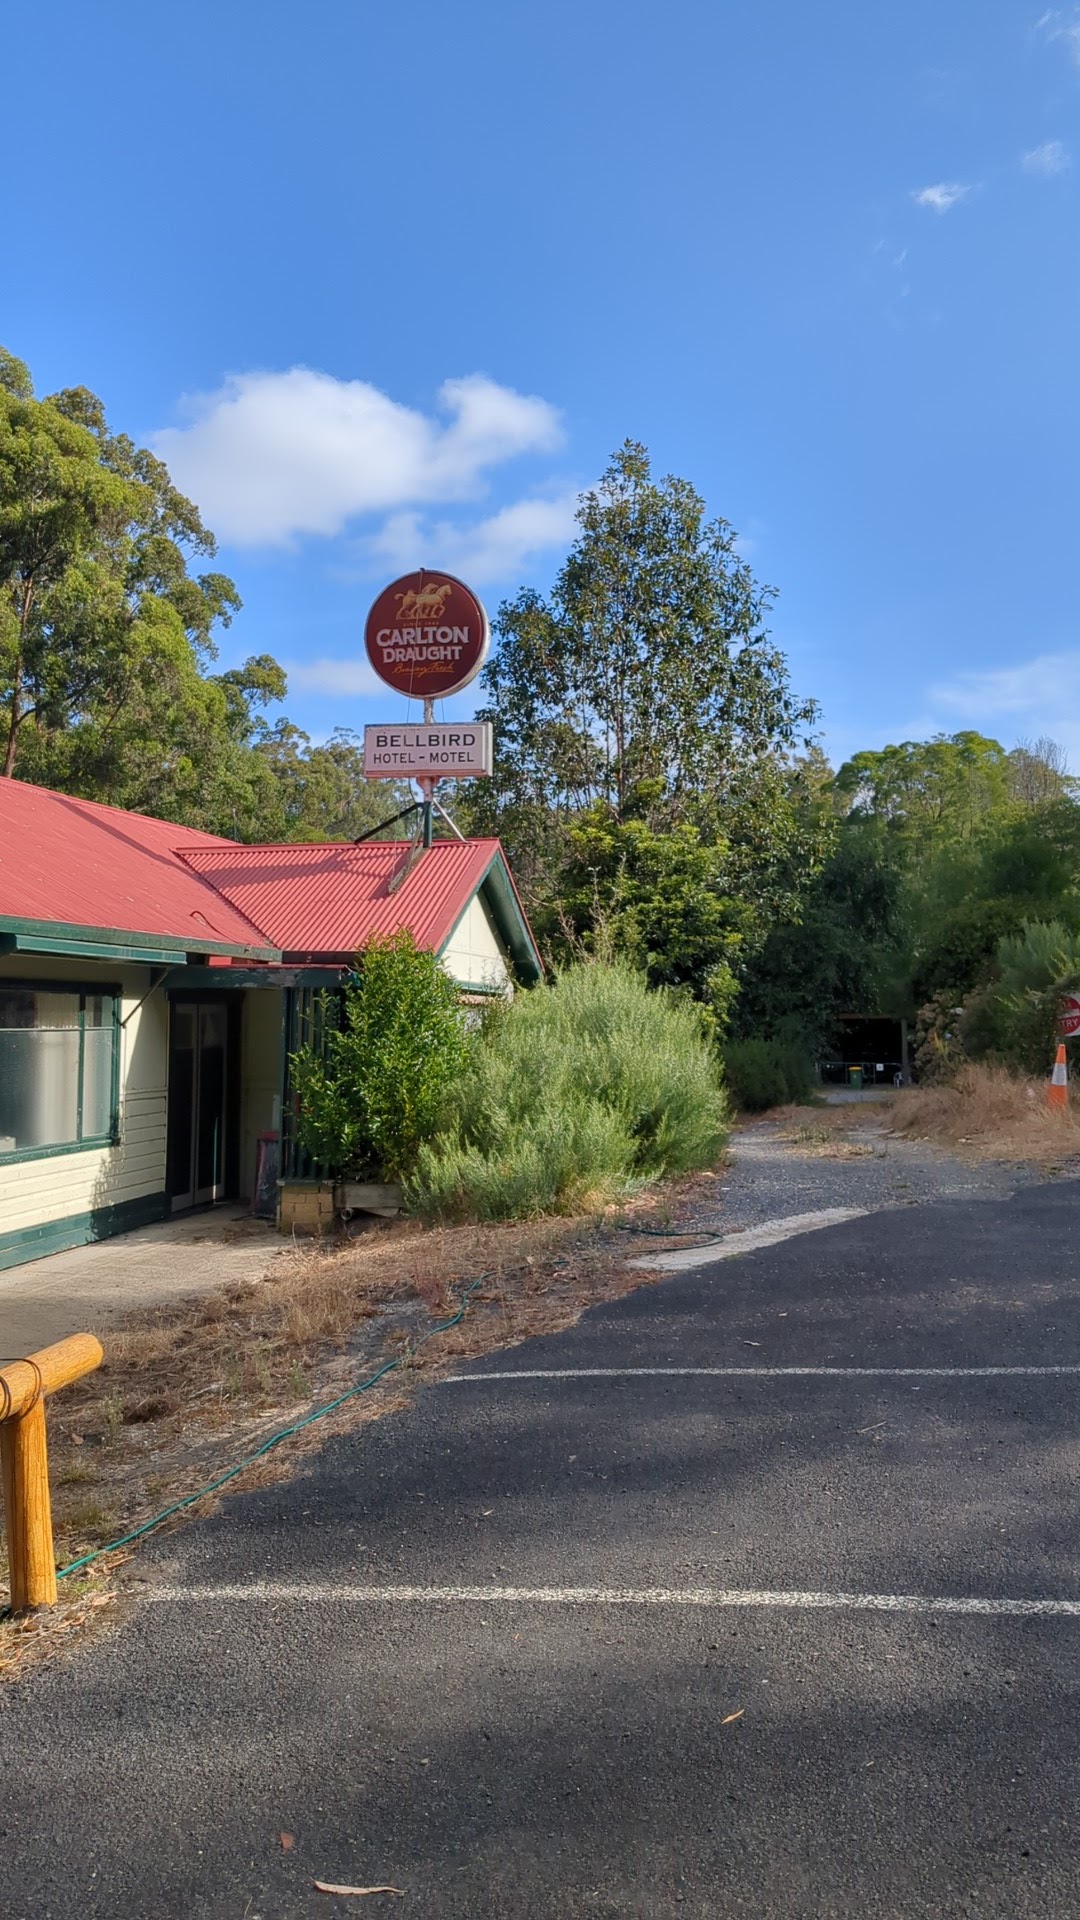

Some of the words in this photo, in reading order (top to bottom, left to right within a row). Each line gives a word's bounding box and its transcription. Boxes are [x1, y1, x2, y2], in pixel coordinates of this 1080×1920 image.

[376, 626, 470, 647] CARLTON
[382, 646, 463, 664] DRAUGHT
[376, 734, 476, 748] BELLBIRD
[373, 752, 416, 764] HOTEL
[429, 751, 475, 763] MOTEL
[1058, 1018, 1078, 1027] TRY
